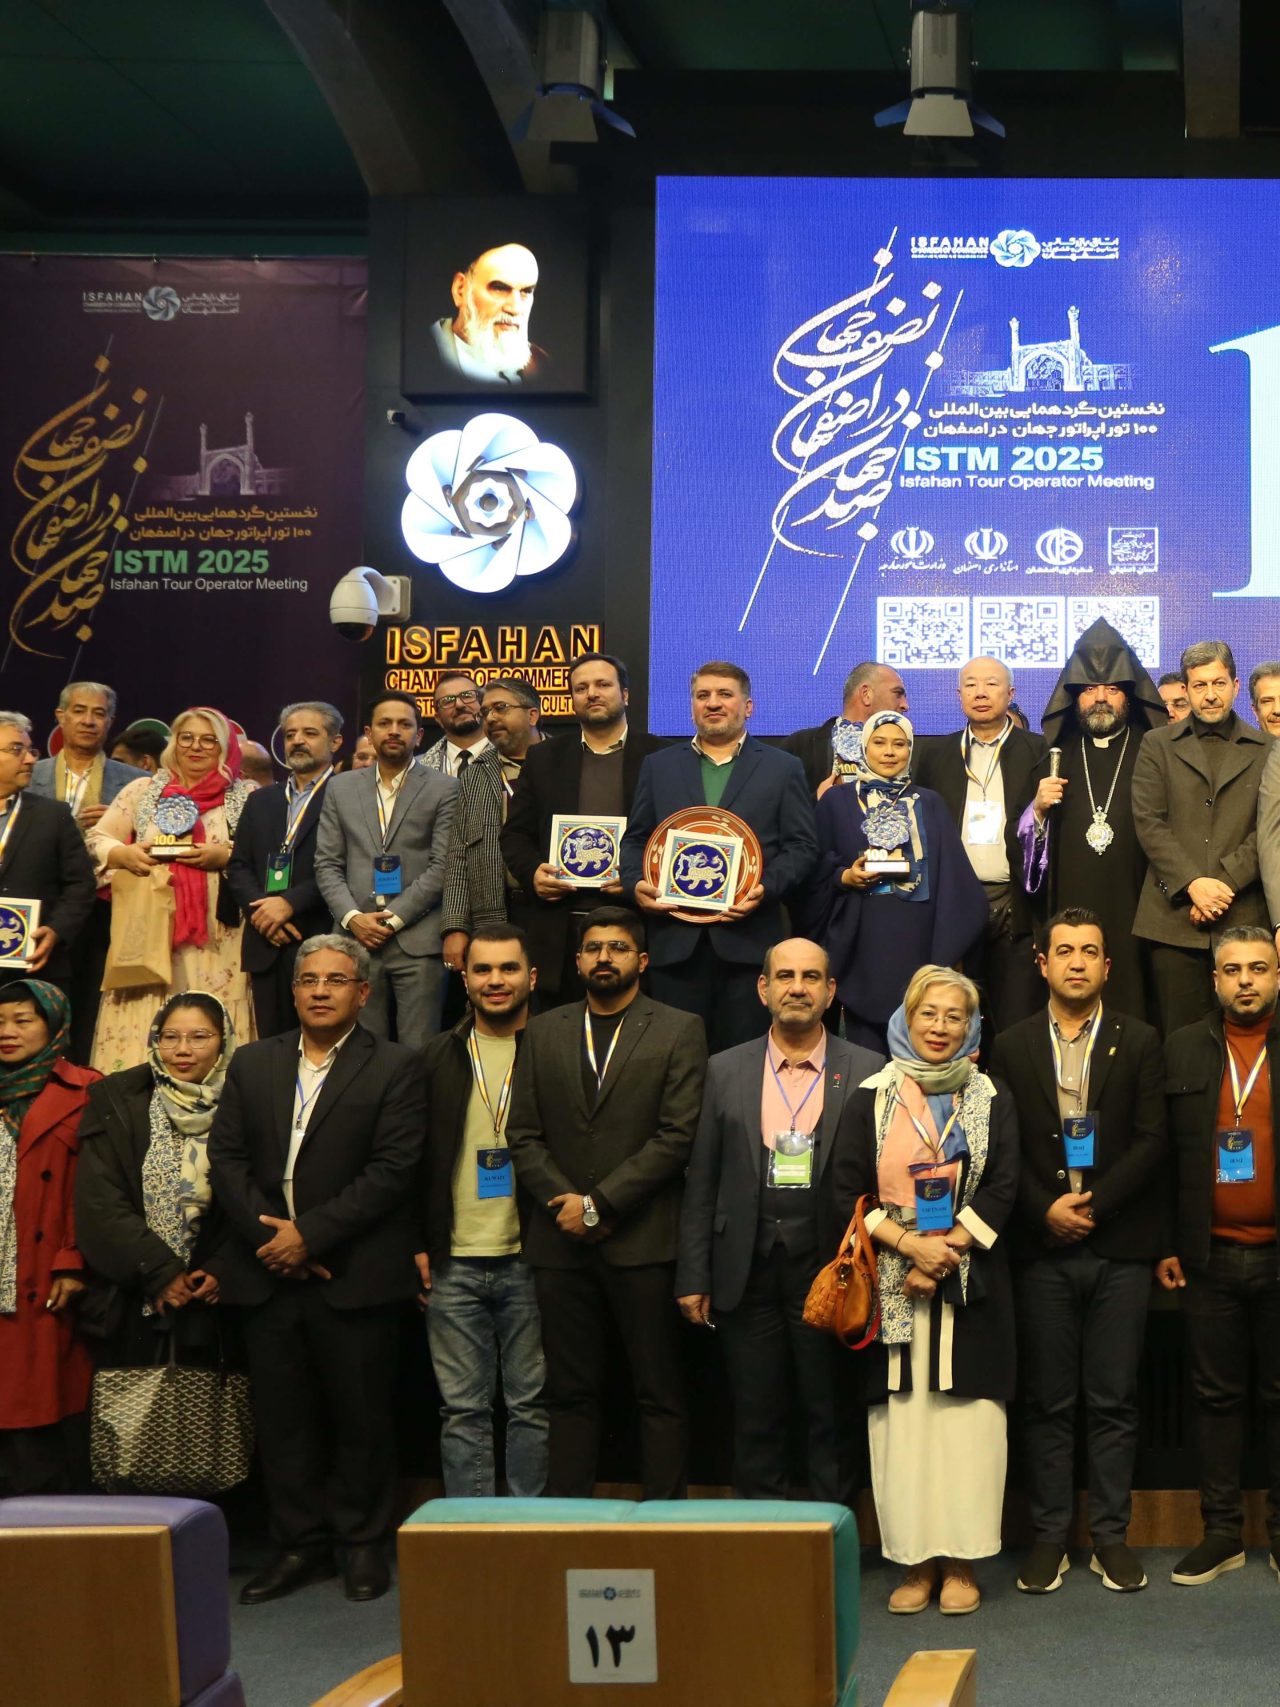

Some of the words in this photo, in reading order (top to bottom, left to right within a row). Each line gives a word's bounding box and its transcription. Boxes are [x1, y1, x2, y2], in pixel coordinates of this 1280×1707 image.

[910, 236, 990, 248] ISFAHAN
[82, 291, 142, 302] ISFAHAN
[929, 402, 979, 419] المللی
[979, 406, 1009, 419] بین
[1010, 400, 1097, 418] گردهمایی
[1098, 402, 1166, 418] نخستین
[924, 421, 988, 437] اصفهان
[988, 424, 1008, 437] در
[1012, 421, 1058, 438] جهان
[904, 446, 999, 471] ISTM
[1010, 446, 1105, 471] 2025
[900, 474, 962, 489] Isfahan
[965, 475, 1005, 488] Tour
[1008, 474, 1084, 490] Operator
[1087, 474, 1156, 490] Meeting
[134, 506, 173, 521] المللی
[174, 508, 197, 521] بین
[265, 506, 318, 521] نخستین
[129, 526, 180, 541] اصفهان
[199, 525, 234, 542] جهان
[114, 549, 188, 574] ISTM
[197, 549, 270, 574] 2025
[110, 577, 159, 591] Isfahan
[162, 578, 192, 591] Tour
[195, 577, 253, 592] Operator
[256, 577, 308, 592] Meeting
[386, 624, 601, 664] ISFAHAN
[385, 667, 475, 694] CHAM
[154, 834, 176, 846] 100
[864, 849, 888, 861] 100
[585, 1624, 636, 1668] ۱۳
